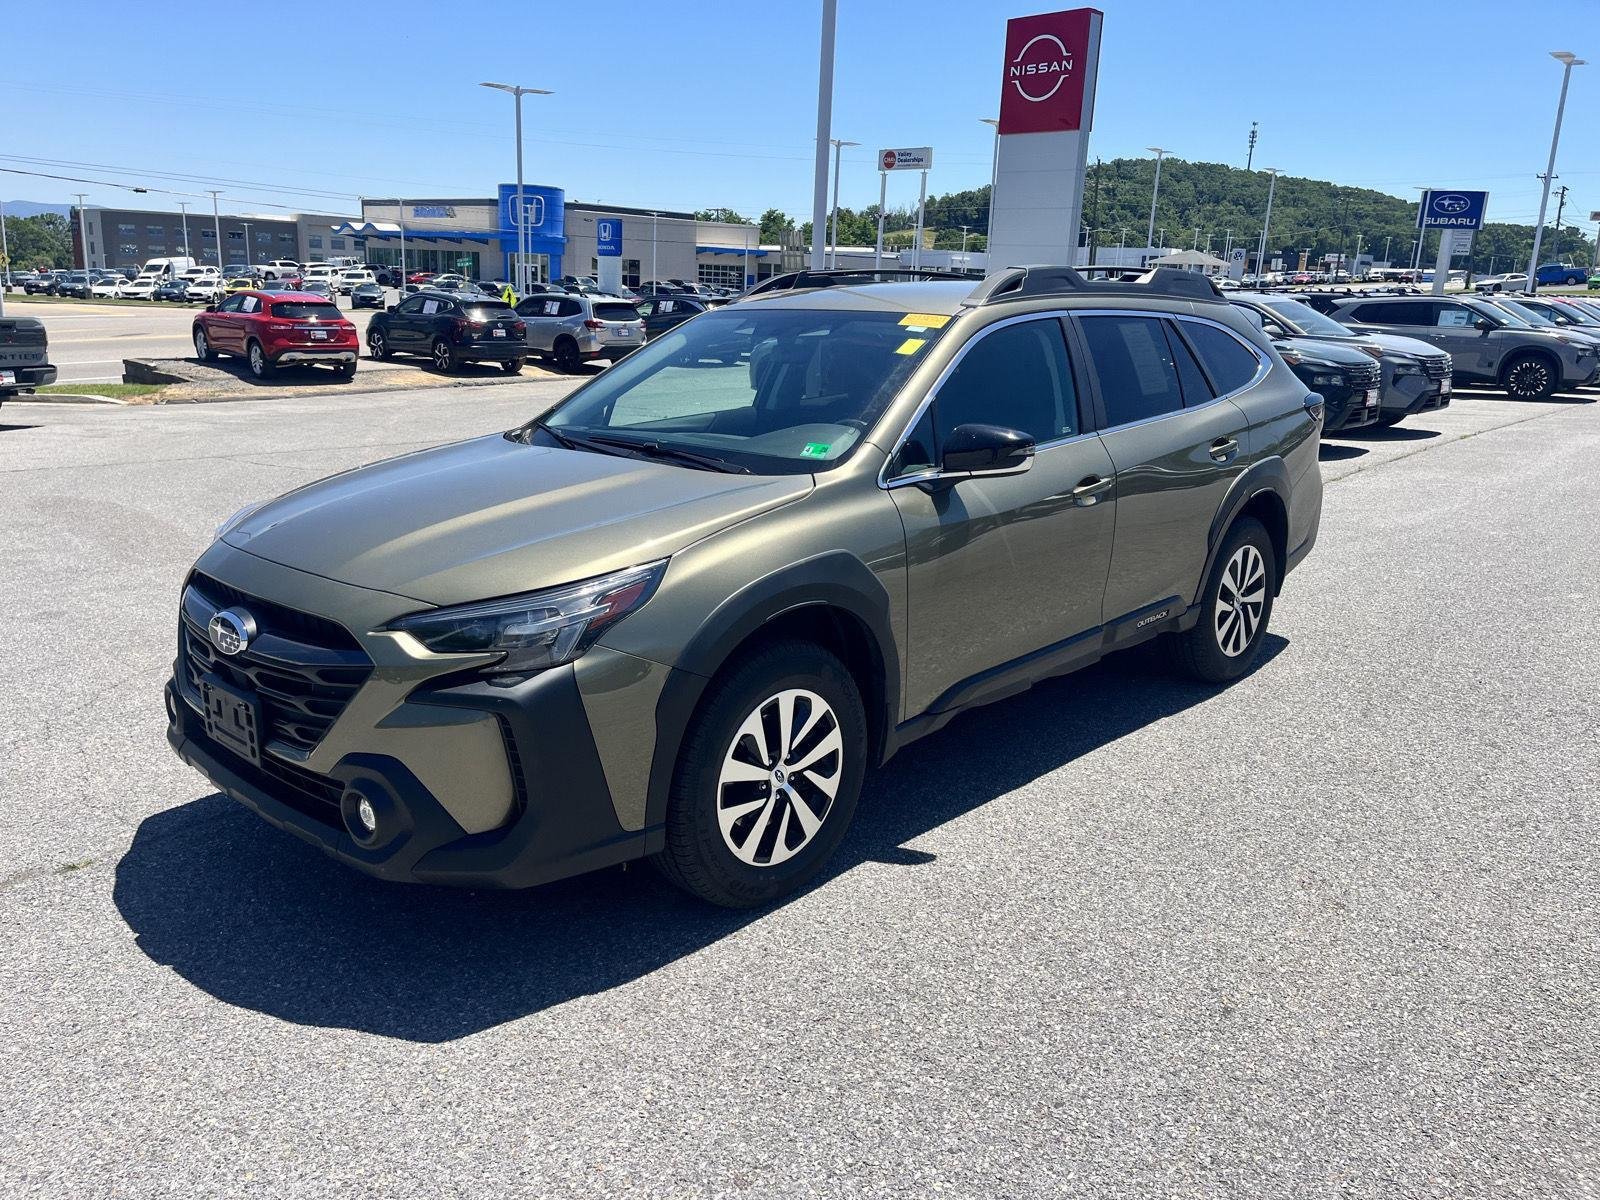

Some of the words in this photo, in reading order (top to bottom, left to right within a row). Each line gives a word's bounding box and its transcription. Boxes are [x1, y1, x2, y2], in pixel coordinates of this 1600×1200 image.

[1010, 59, 1073, 77] NISSAN
[1424, 217, 1476, 226] SUBARU
[1137, 610, 1169, 628] OUTBACK
